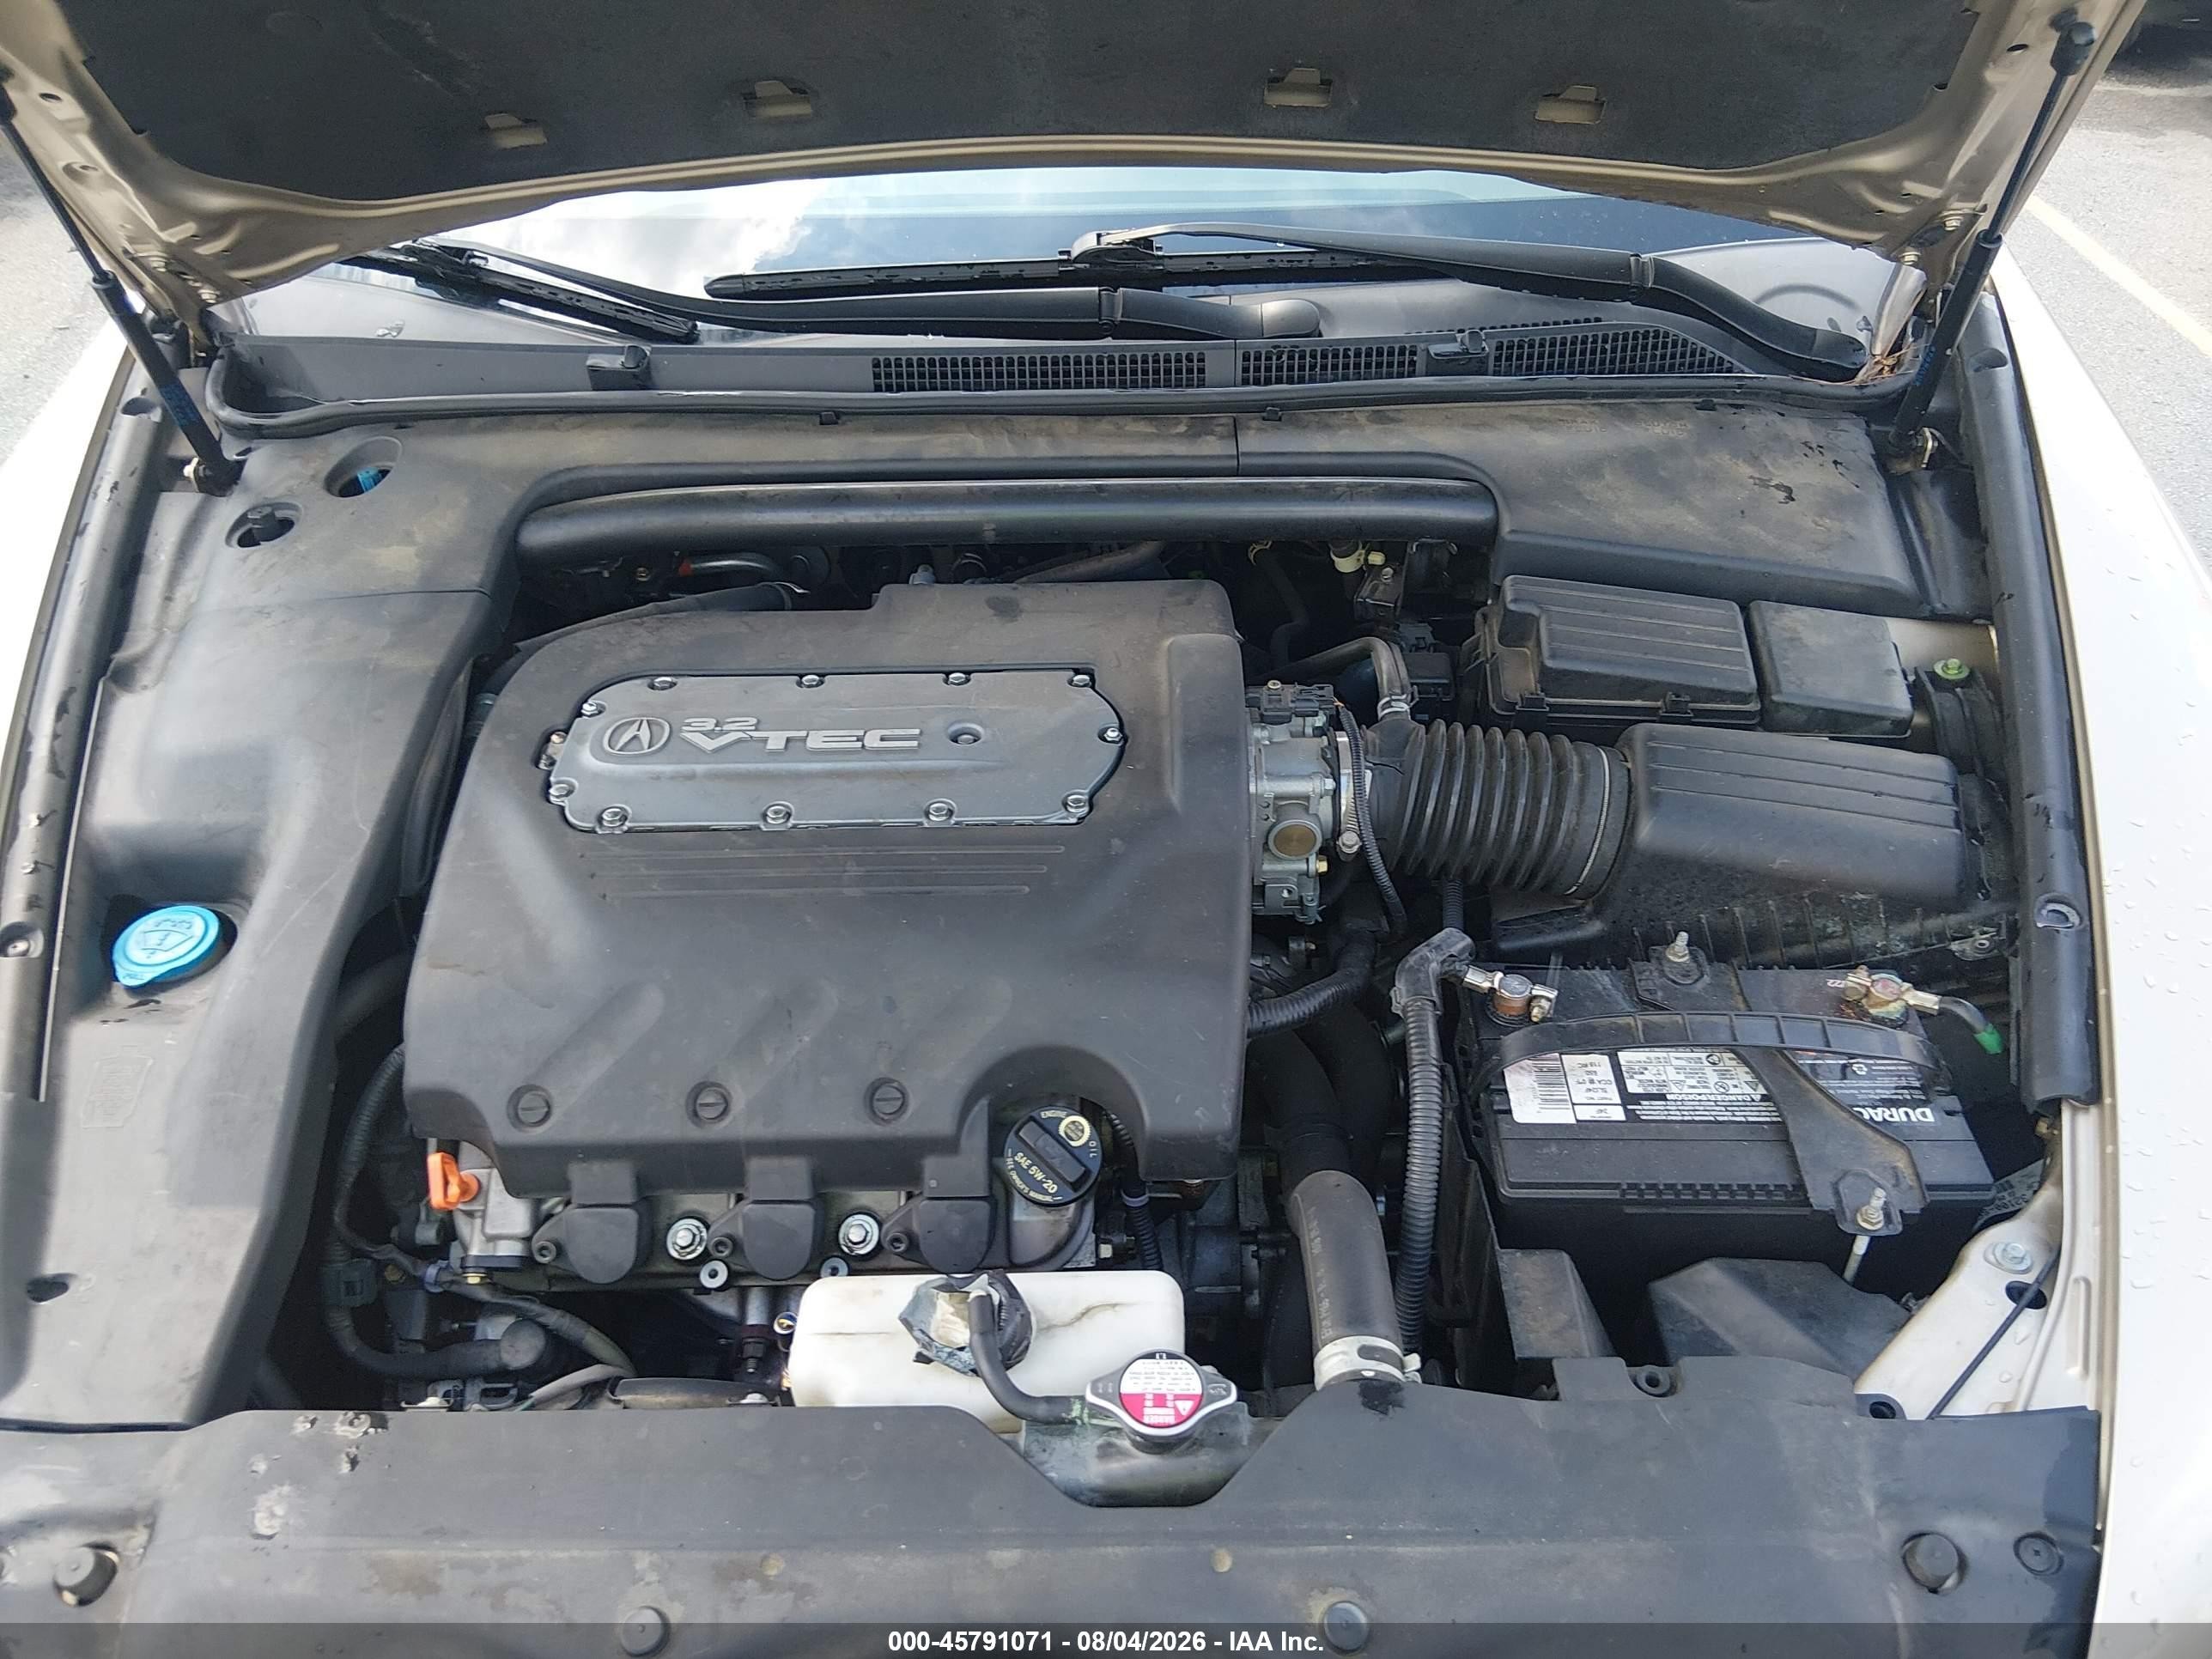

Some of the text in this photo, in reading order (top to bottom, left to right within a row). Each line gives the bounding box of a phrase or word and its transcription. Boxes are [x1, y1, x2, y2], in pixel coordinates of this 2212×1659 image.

[681, 717, 757, 731] 3.2
[680, 728, 921, 753] VTEC
[1852, 1107, 1936, 1122] DURAC
[1088, 1140, 1098, 1158] OIL
[1014, 1152, 1058, 1194] SAE 5W-20
